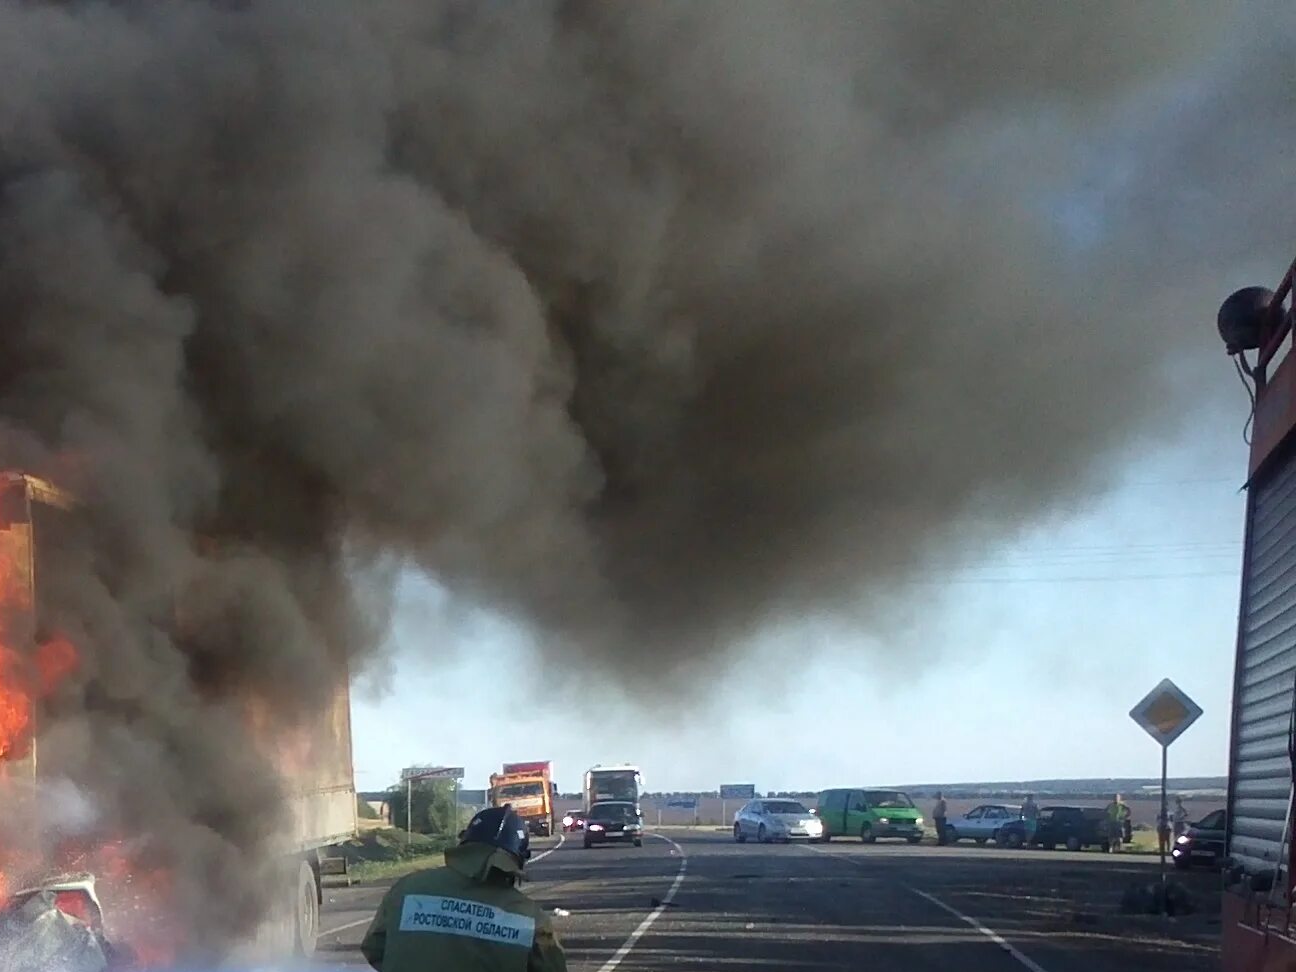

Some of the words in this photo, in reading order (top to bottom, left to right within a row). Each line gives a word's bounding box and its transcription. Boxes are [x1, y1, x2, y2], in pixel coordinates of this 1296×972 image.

[441, 899, 495, 919] СПАСАТЕЛЬ
[413, 912, 472, 931] РОСТОВСКОЙ
[475, 920, 519, 939] ОБЛАСТИ
